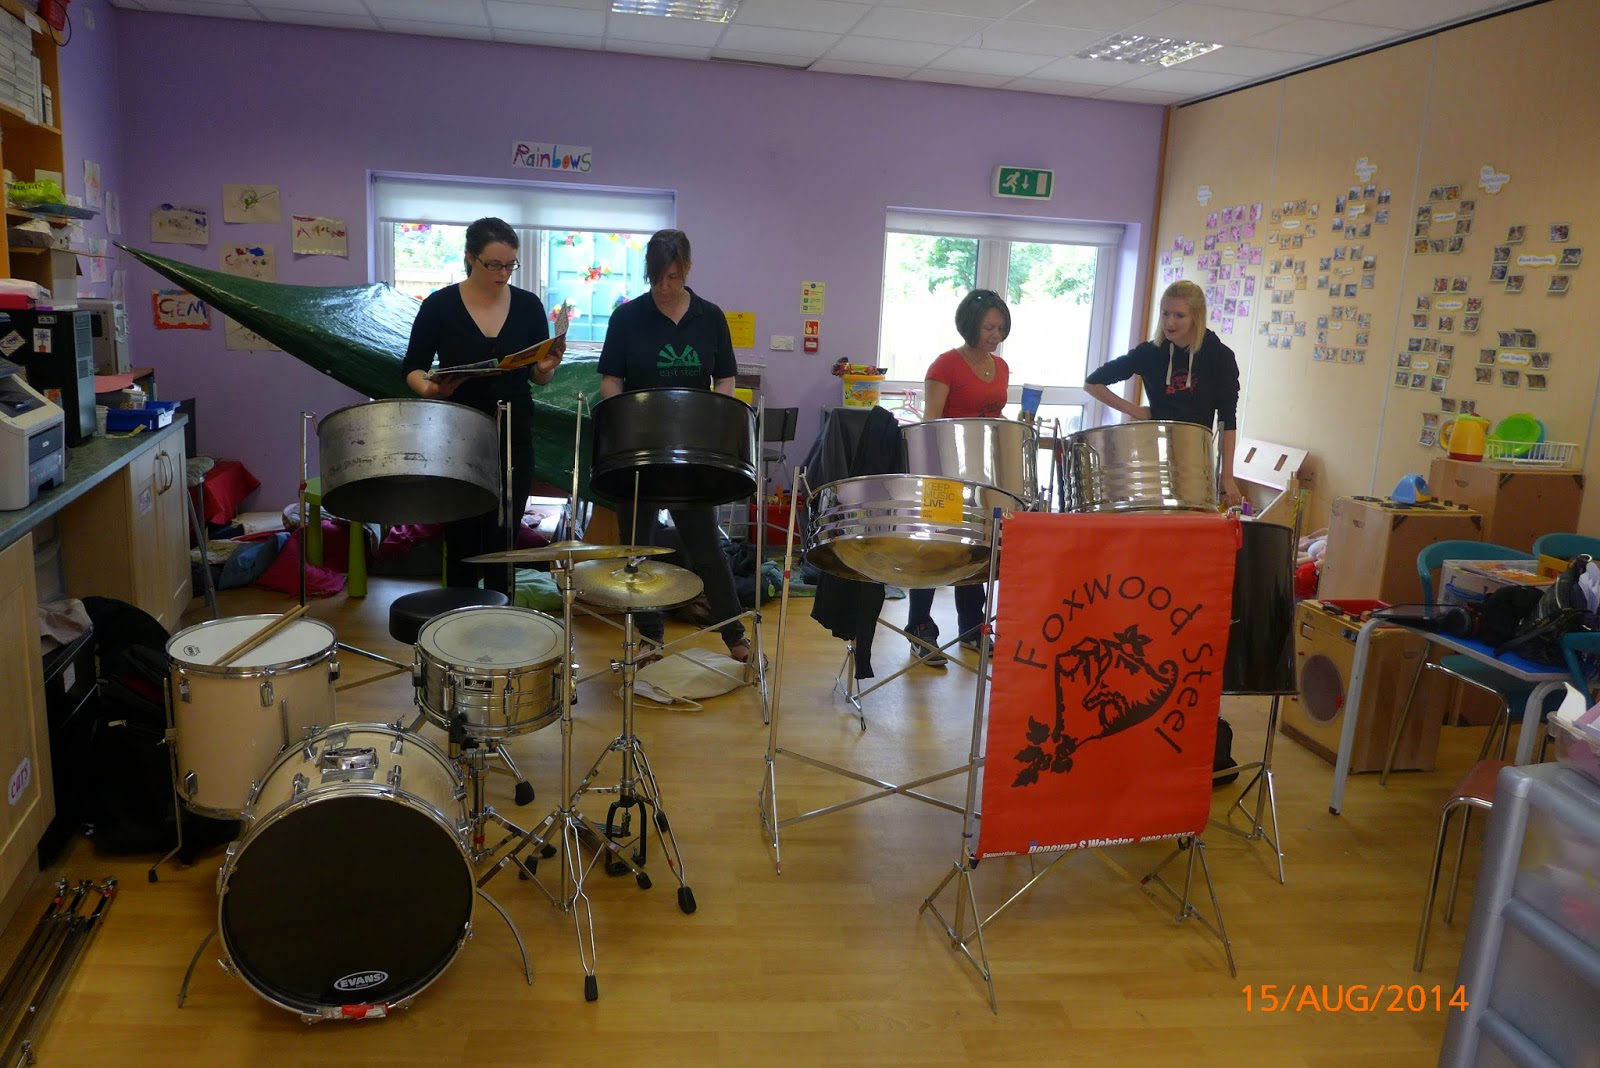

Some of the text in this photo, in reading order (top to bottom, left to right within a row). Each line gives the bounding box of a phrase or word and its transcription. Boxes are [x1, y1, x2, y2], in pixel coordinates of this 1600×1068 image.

[159, 299, 208, 319] GEM
[660, 368, 678, 377] east
[924, 481, 950, 491] KEEP
[924, 490, 955, 501] MUSIC
[923, 498, 945, 508] LIVE
[1154, 642, 1213, 754] Steel
[340, 973, 381, 988] EVANS
